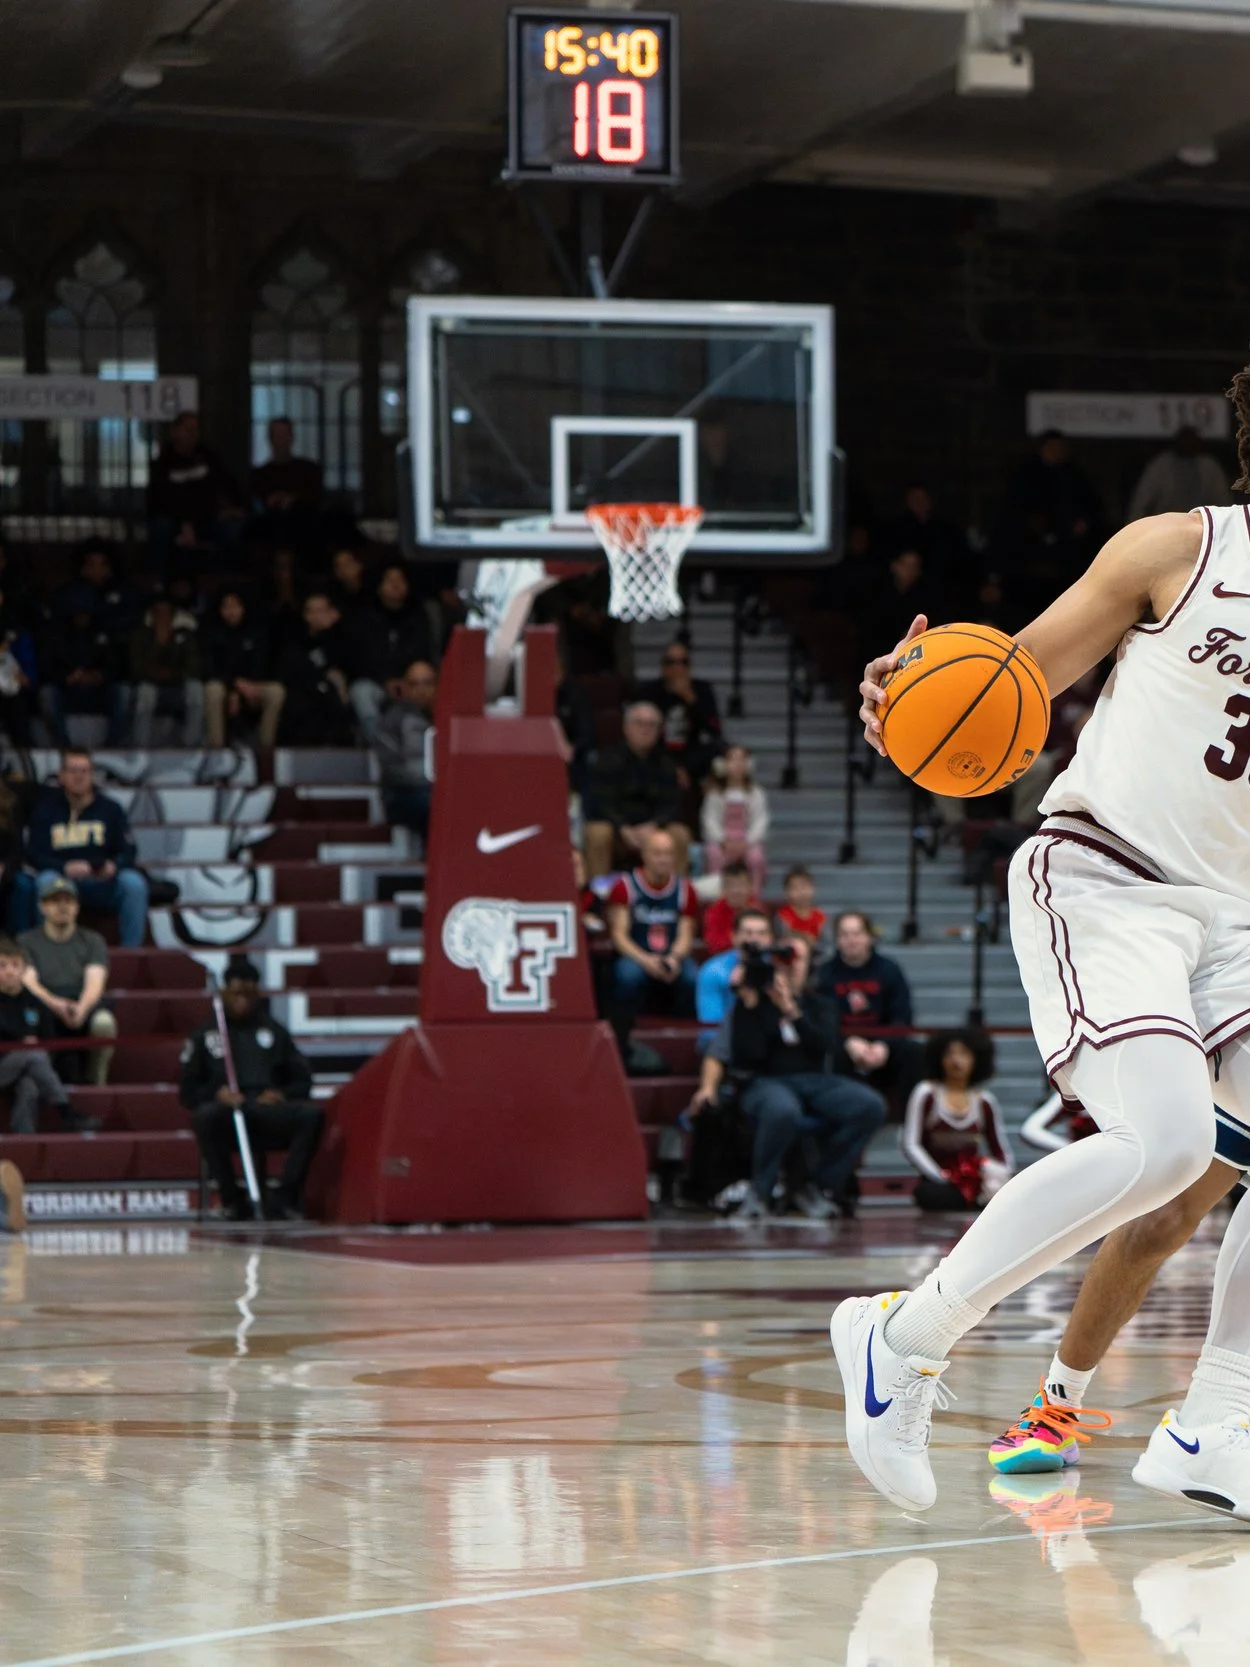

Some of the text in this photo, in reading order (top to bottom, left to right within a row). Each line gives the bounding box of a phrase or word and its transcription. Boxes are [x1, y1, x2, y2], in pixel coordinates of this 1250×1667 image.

[544, 26, 659, 77] 15:40
[574, 79, 644, 163] 18
[127, 1189, 189, 1212] RAMS
